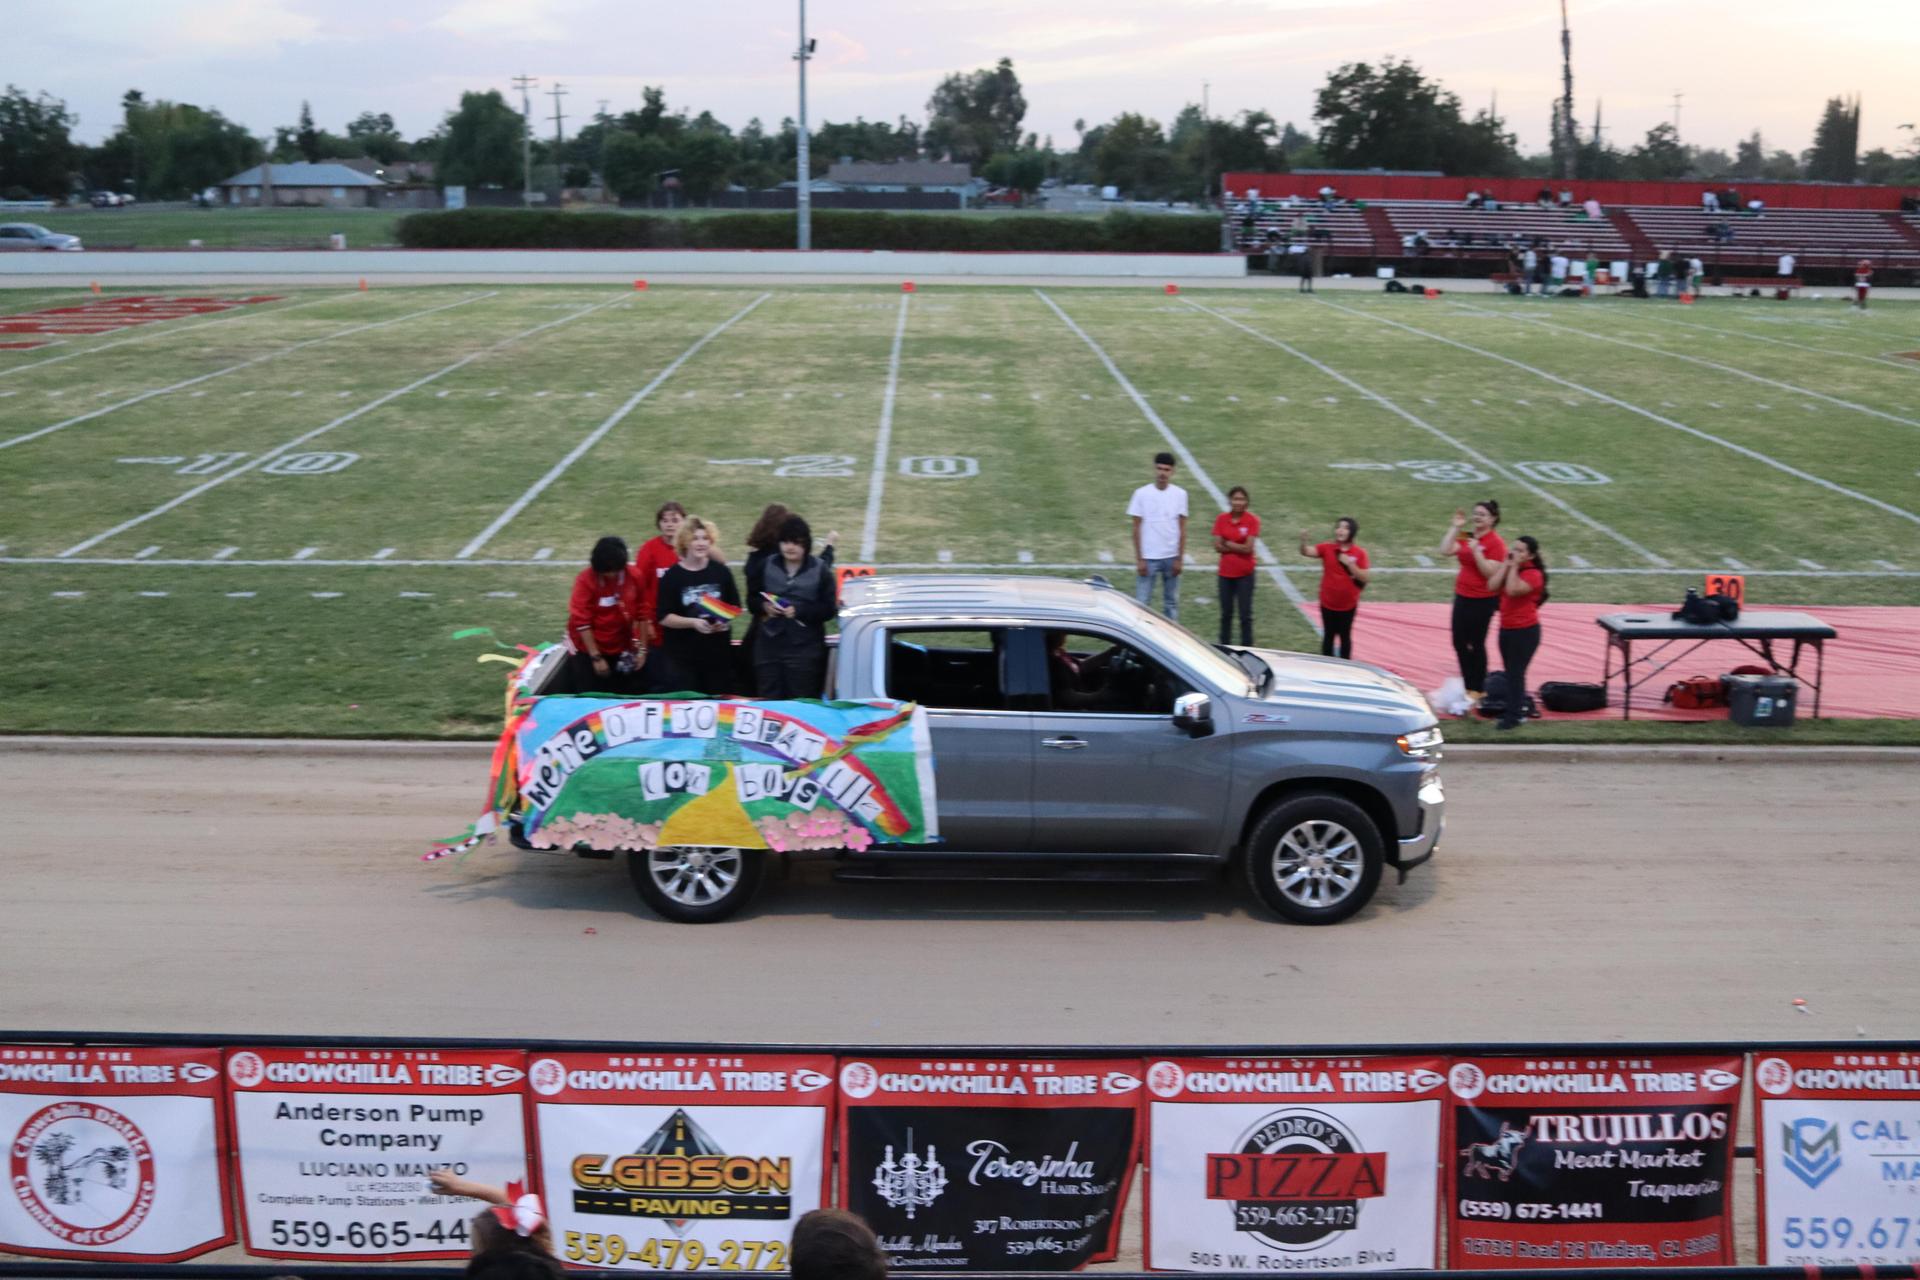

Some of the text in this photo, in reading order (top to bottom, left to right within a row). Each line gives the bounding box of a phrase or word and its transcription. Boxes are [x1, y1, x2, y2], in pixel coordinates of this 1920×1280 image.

[3, 1051, 133, 1061] HOME OF THE
[305, 1051, 440, 1060] HOME OF THE
[608, 1057, 744, 1067] HOME OF THE
[1226, 1060, 1363, 1068] HOME OF THE
[1525, 1060, 1653, 1070] HOME OF THE
[1833, 1056, 1889, 1066] HOME
[110, 1065, 176, 1083] TRIBE
[265, 1063, 484, 1086] CHOWCHILLA TRIBE
[920, 1062, 1056, 1072] HOME OF THE
[566, 1070, 787, 1092] CHOWCHILLA TRIBE
[878, 1074, 1098, 1095] CHOWCHILLA TRIBE
[1185, 1072, 1408, 1093] CHOWCHILLA TRIBE
[1486, 1072, 1697, 1093] CHOWCHILLA TRIBE
[275, 1102, 484, 1126] Anderson Pump
[1252, 1118, 1344, 1149] PEDRO'S
[1529, 1112, 1728, 1145] TRUJILLOS
[1851, 1120, 1910, 1141] CAL
[320, 1129, 443, 1151] Company
[966, 1140, 1096, 1187] Terezinha
[1553, 1148, 1706, 1169] Meat Market
[300, 1162, 389, 1178] LUCIANO
[572, 1154, 791, 1195] C.GIBSON
[1211, 1157, 1385, 1199] PIZZA
[257, 1193, 314, 1206] Complete
[319, 1195, 351, 1207] Pump
[356, 1195, 406, 1207] Stations
[1627, 1179, 1721, 1203] Taqueria
[630, 1198, 731, 1216] PAVING
[1237, 1206, 1354, 1226] 559-665-2473
[1460, 1200, 1603, 1220] (559) 675-1441
[271, 1219, 474, 1249] 559-665-44
[1783, 1217, 1920, 1250] 559.67
[564, 1230, 791, 1272] 559-479-272
[1190, 1248, 1397, 1270] 505 W. Robertson Blvd
[1515, 1240, 1562, 1259] Road
[1564, 1241, 1586, 1259] 26
[1588, 1240, 1657, 1261] Madera,
[1660, 1240, 1681, 1258] CA
